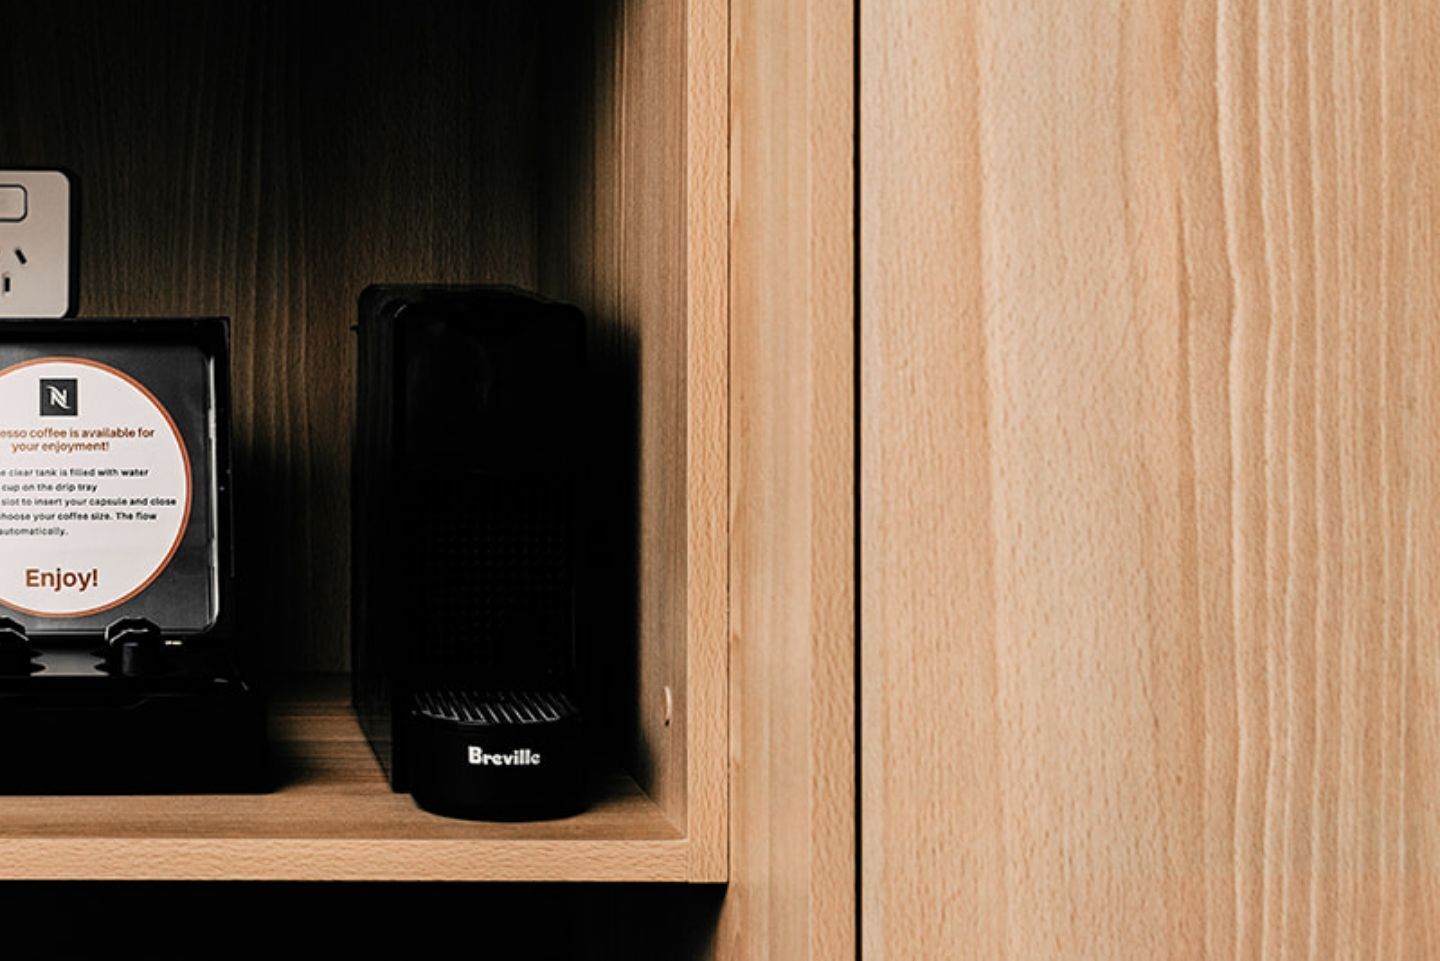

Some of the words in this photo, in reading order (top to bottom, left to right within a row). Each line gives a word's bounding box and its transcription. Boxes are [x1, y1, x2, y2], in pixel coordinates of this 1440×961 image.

[29, 428, 67, 438] coffee
[69, 428, 79, 438] is
[82, 428, 135, 438] available
[138, 428, 155, 438] for
[12, 443, 38, 453] your
[41, 442, 109, 453] enjoyment!
[2, 485, 20, 493] cup
[55, 484, 76, 493] drip
[78, 484, 97, 493] tray
[64, 499, 87, 507] your
[89, 499, 127, 507] capsule
[25, 568, 98, 592] Enjoy!
[468, 746, 541, 765] Breville
